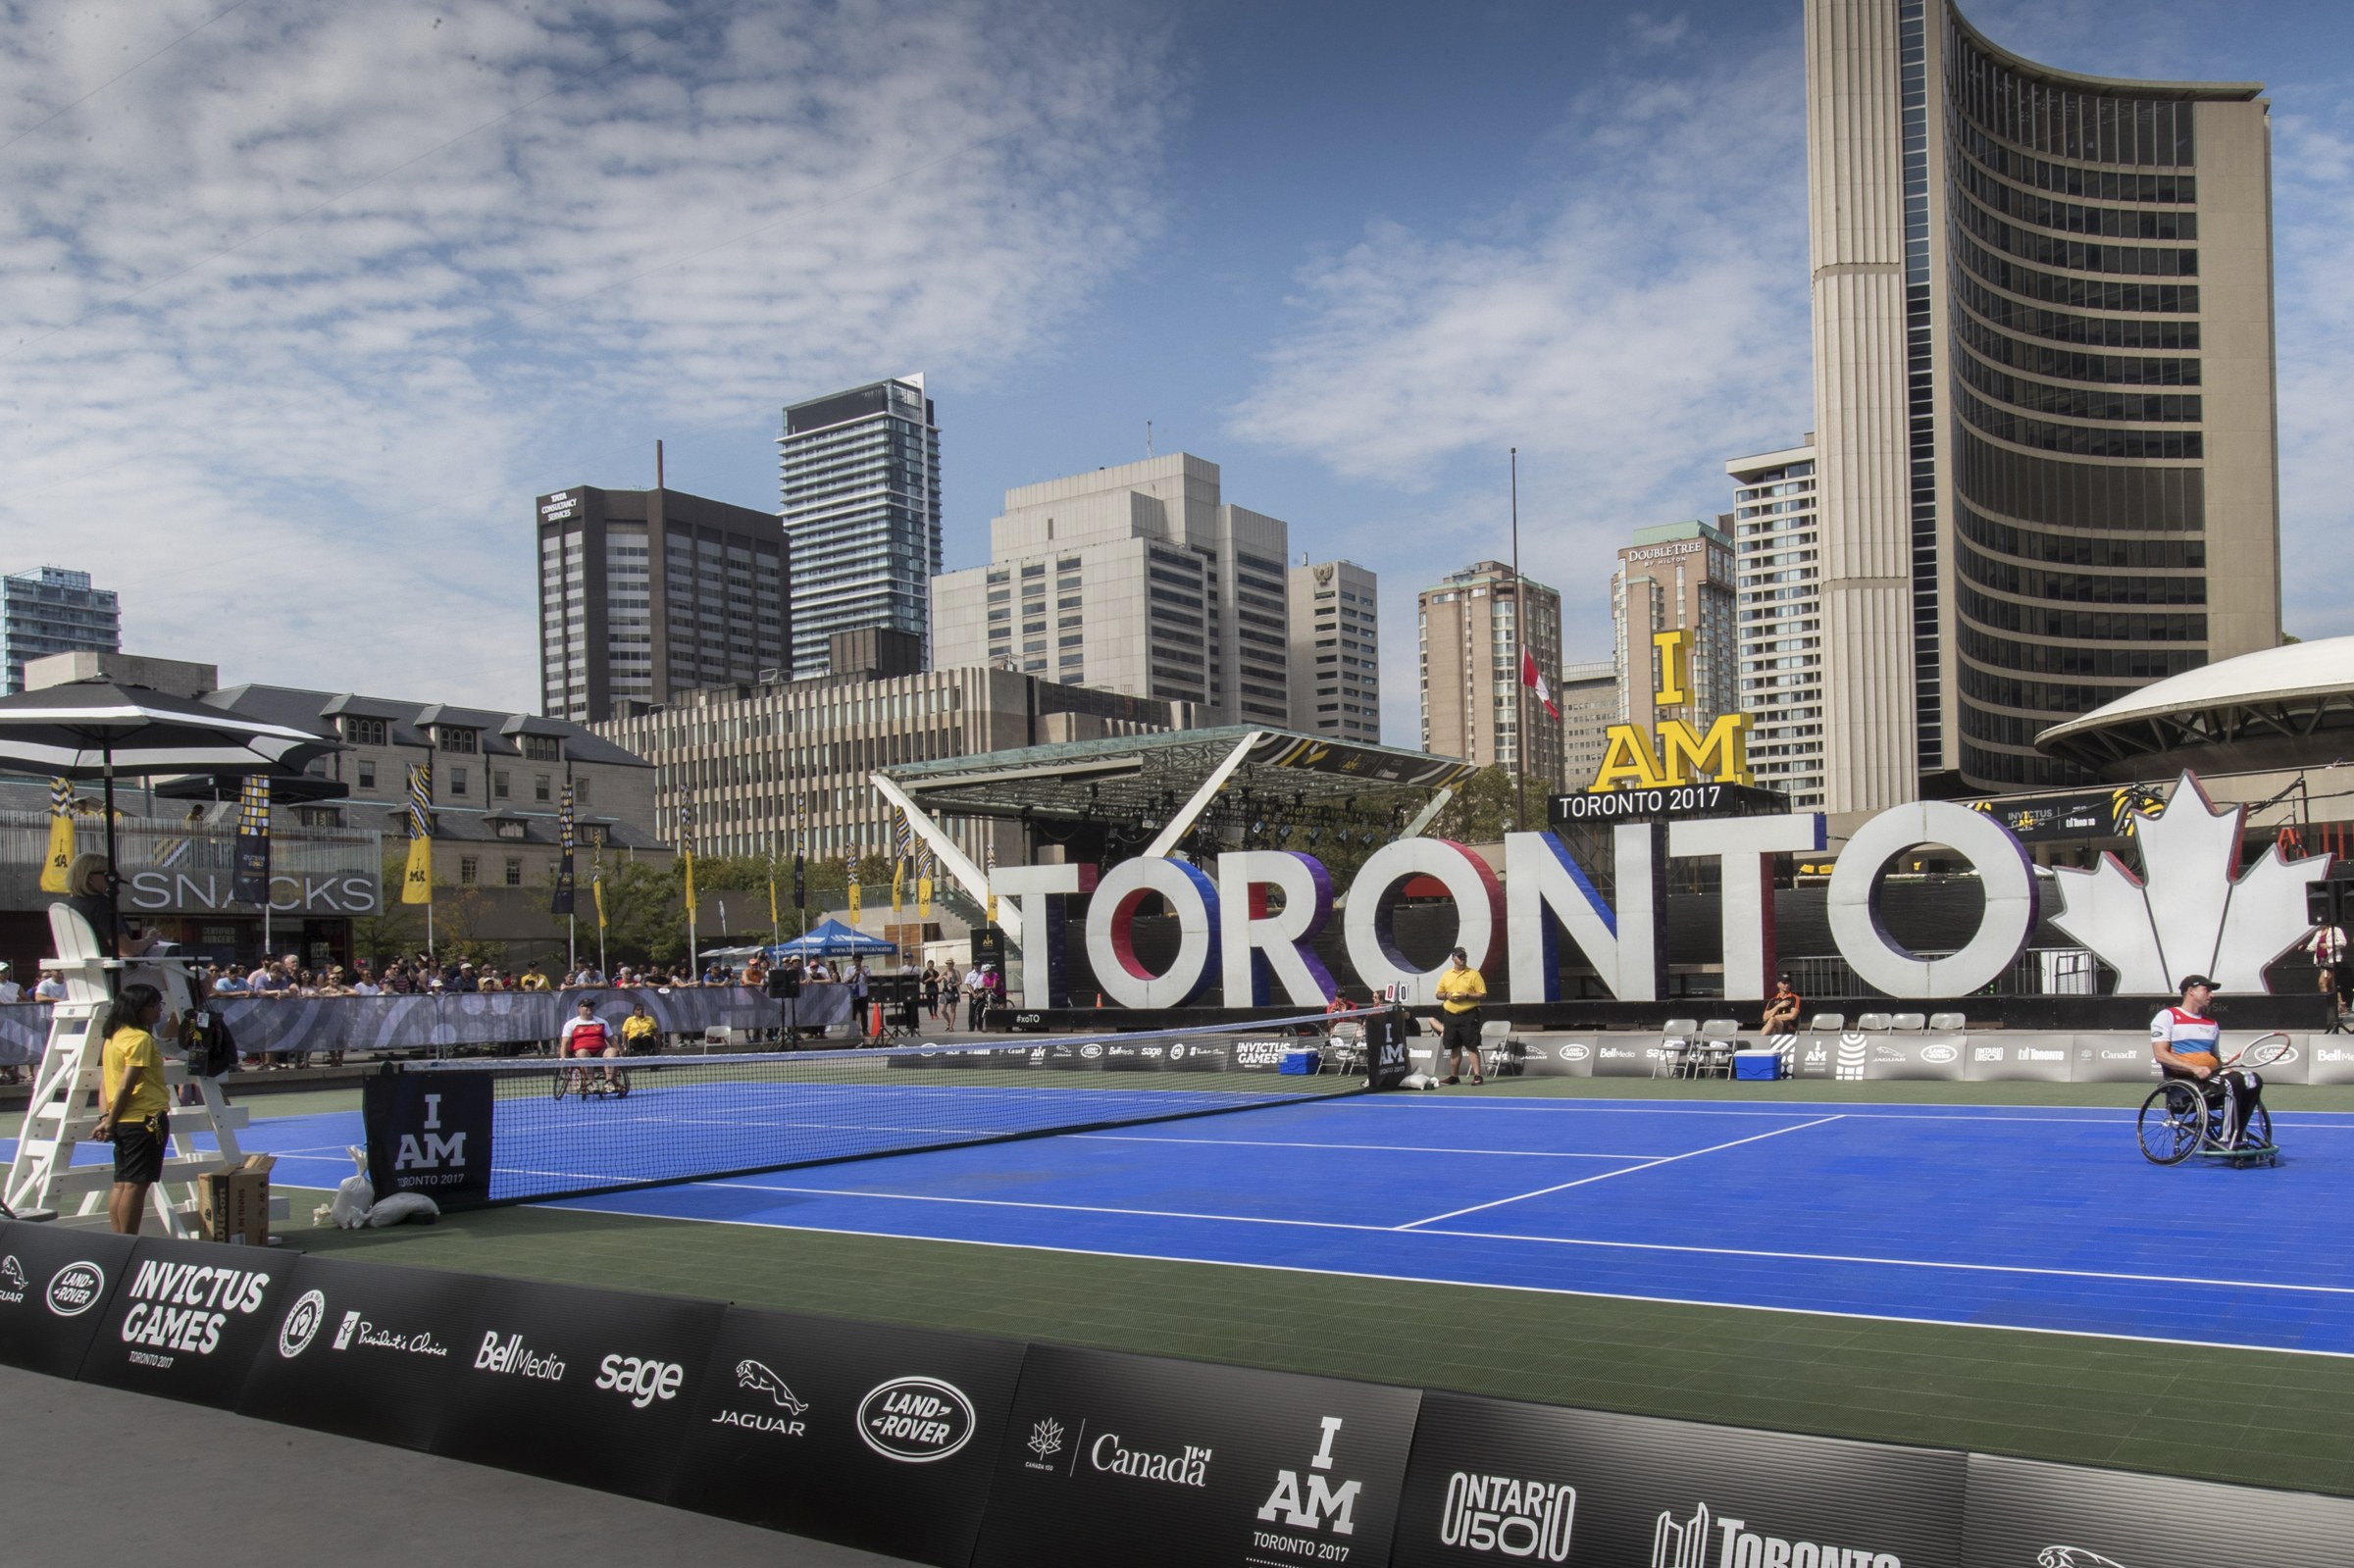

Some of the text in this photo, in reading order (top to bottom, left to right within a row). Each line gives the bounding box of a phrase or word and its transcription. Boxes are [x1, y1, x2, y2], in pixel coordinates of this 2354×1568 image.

[541, 498, 577, 514] CONSULTANCY
[551, 492, 567, 502] TATA
[548, 509, 571, 521] SERVICES
[1653, 630, 1694, 707] I
[1589, 713, 1752, 792] AM
[1560, 785, 1720, 818] TORONTO 2017
[2008, 809, 2053, 820] INVICTUS
[988, 799, 2034, 1009] TORONTO
[1386, 1023, 1392, 1042] I
[1141, 1047, 1162, 1057] sage
[1237, 1042, 1290, 1053] INVICTUS
[1379, 1043, 1405, 1065] AM
[1805, 1051, 1827, 1061] AM
[1816, 1040, 1821, 1050] I
[2101, 1050, 2137, 1059] Canada
[1238, 1053, 1278, 1064] GAMES
[424, 1094, 441, 1129] I
[394, 1132, 467, 1170] AM
[440, 1174, 465, 1184] 2017
[62, 1272, 90, 1289] LAND
[129, 1260, 270, 1313] INVICTUS
[58, 1289, 91, 1304] ROVER
[122, 1302, 227, 1354] GAMES
[358, 1322, 447, 1356] President's Choice
[128, 1351, 174, 1368] TORONTO 2017
[595, 1354, 683, 1407] sage
[883, 1391, 941, 1418] LAND
[712, 1410, 805, 1437] JAGUAR
[880, 1415, 951, 1445] ROVER
[1311, 1416, 1343, 1469] I
[1025, 1461, 1046, 1470] CANADA
[1092, 1434, 1209, 1487] Canada
[1257, 1470, 1361, 1535] AM
[1254, 1531, 1350, 1563] TORONTO 2017
